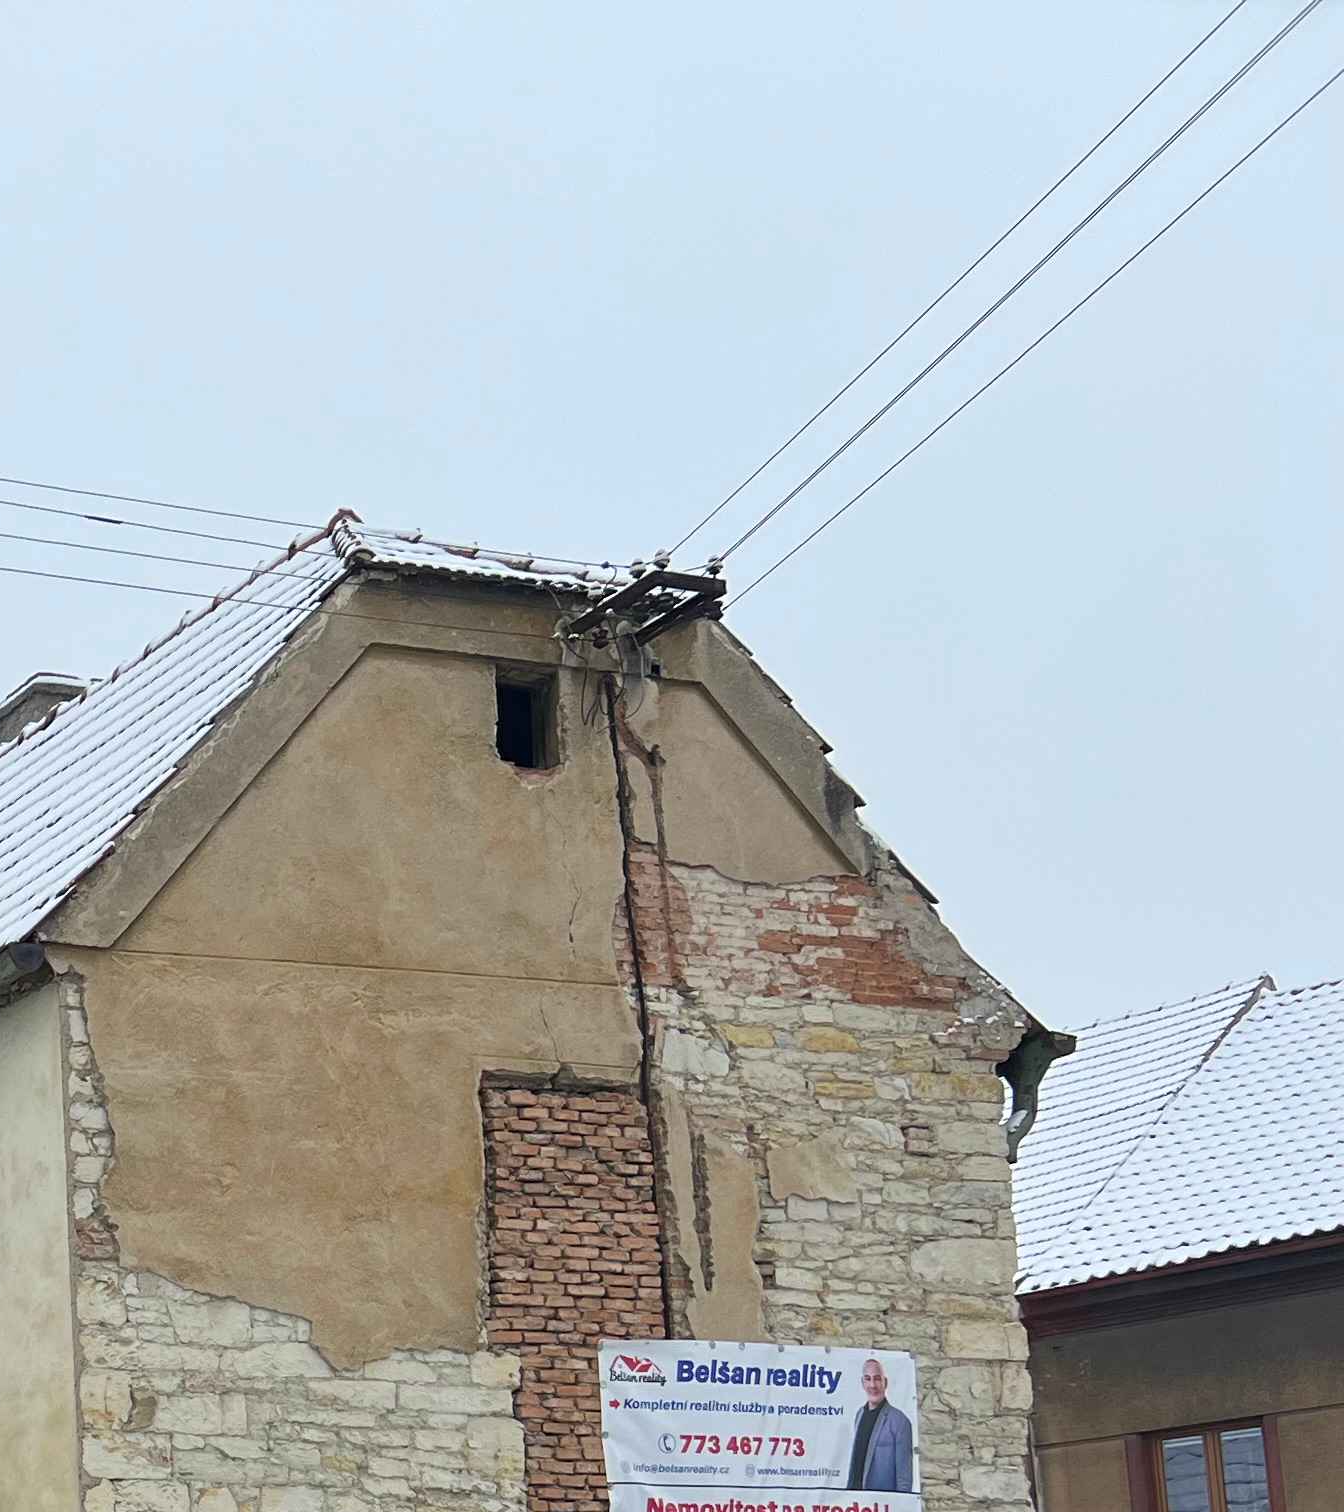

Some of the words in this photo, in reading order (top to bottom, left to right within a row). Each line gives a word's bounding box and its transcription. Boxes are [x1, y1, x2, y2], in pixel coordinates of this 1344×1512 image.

[676, 1359, 761, 1385] Belšan
[766, 1364, 842, 1394] reality
[623, 1399, 688, 1412] Kompletní
[689, 1400, 730, 1412] realitní
[732, 1401, 767, 1416] služby
[767, 1404, 775, 1414] a
[777, 1404, 844, 1416] poradenství
[679, 1434, 721, 1454] 773
[726, 1436, 763, 1456] 467
[769, 1437, 805, 1457] 773
